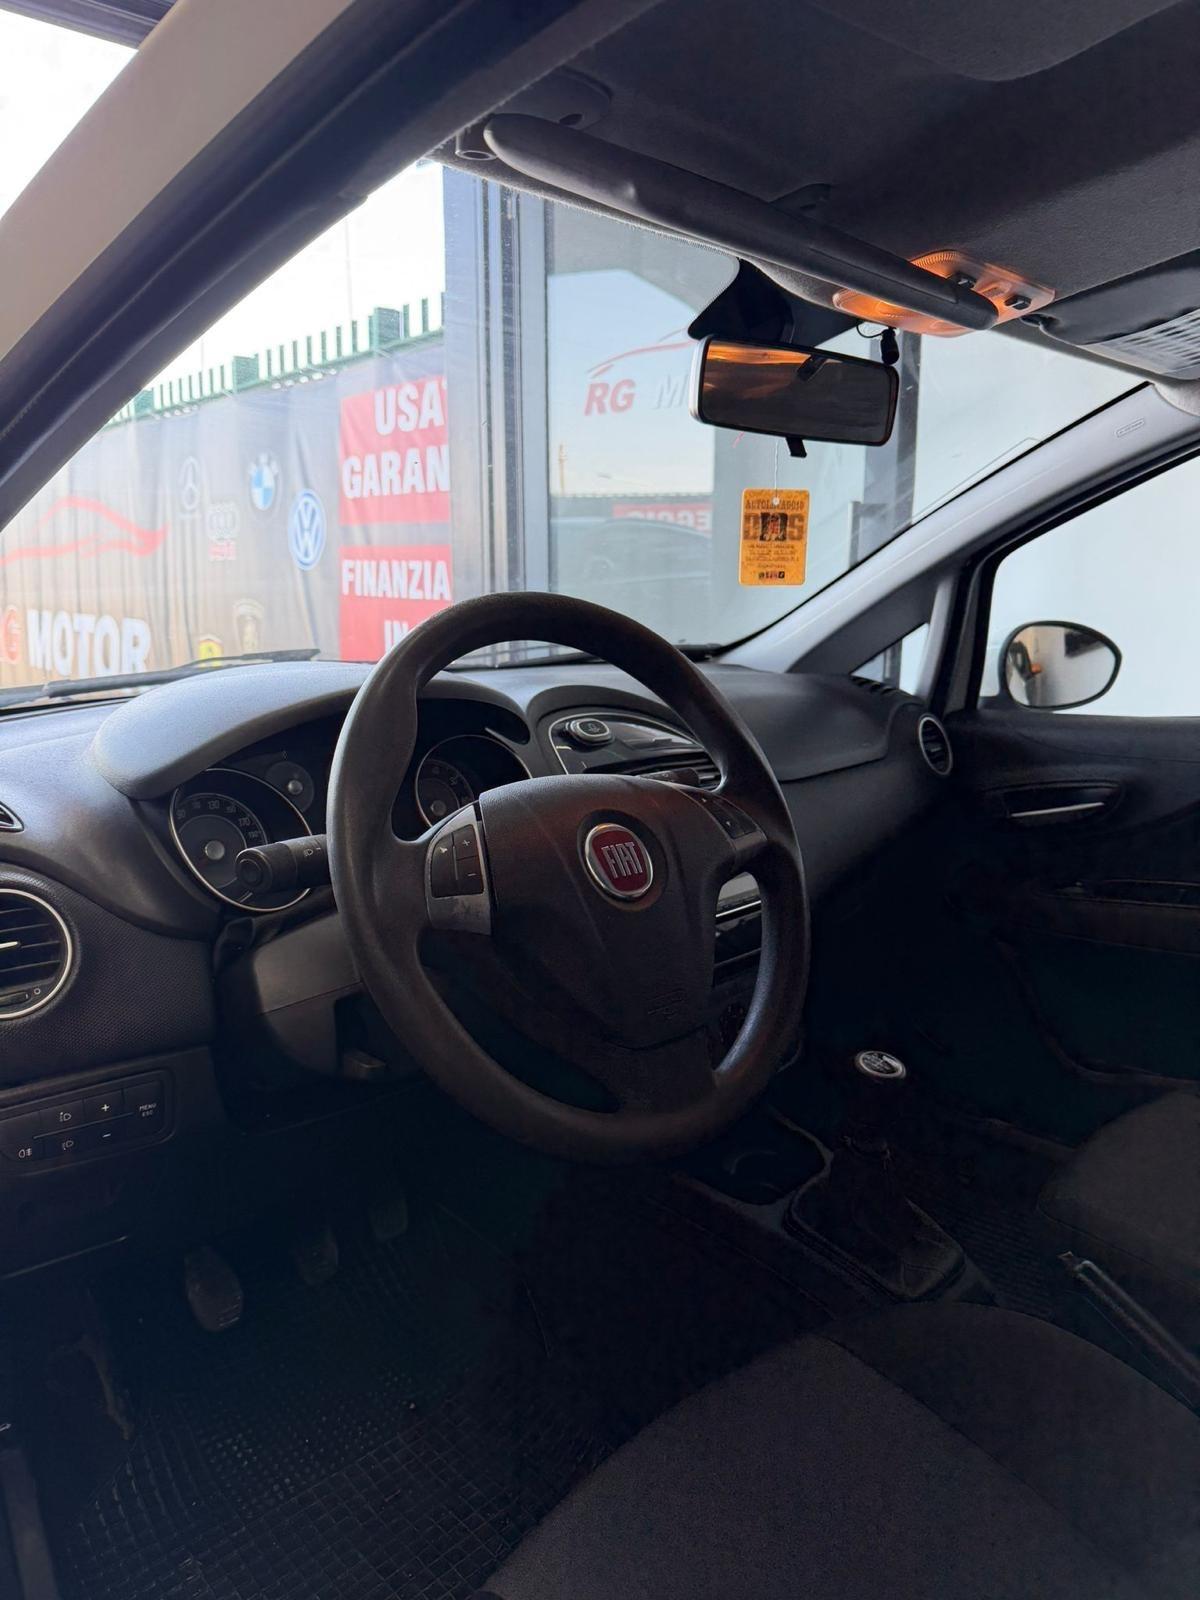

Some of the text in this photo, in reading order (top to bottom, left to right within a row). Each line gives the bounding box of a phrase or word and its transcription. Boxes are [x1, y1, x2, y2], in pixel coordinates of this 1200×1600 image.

[374, 377, 448, 436] USA
[584, 378, 636, 417] RG
[342, 445, 450, 498] GARAN
[342, 560, 451, 600] FINANZIA
[27, 609, 150, 678] MOTOR
[601, 841, 643, 879] FIAT
